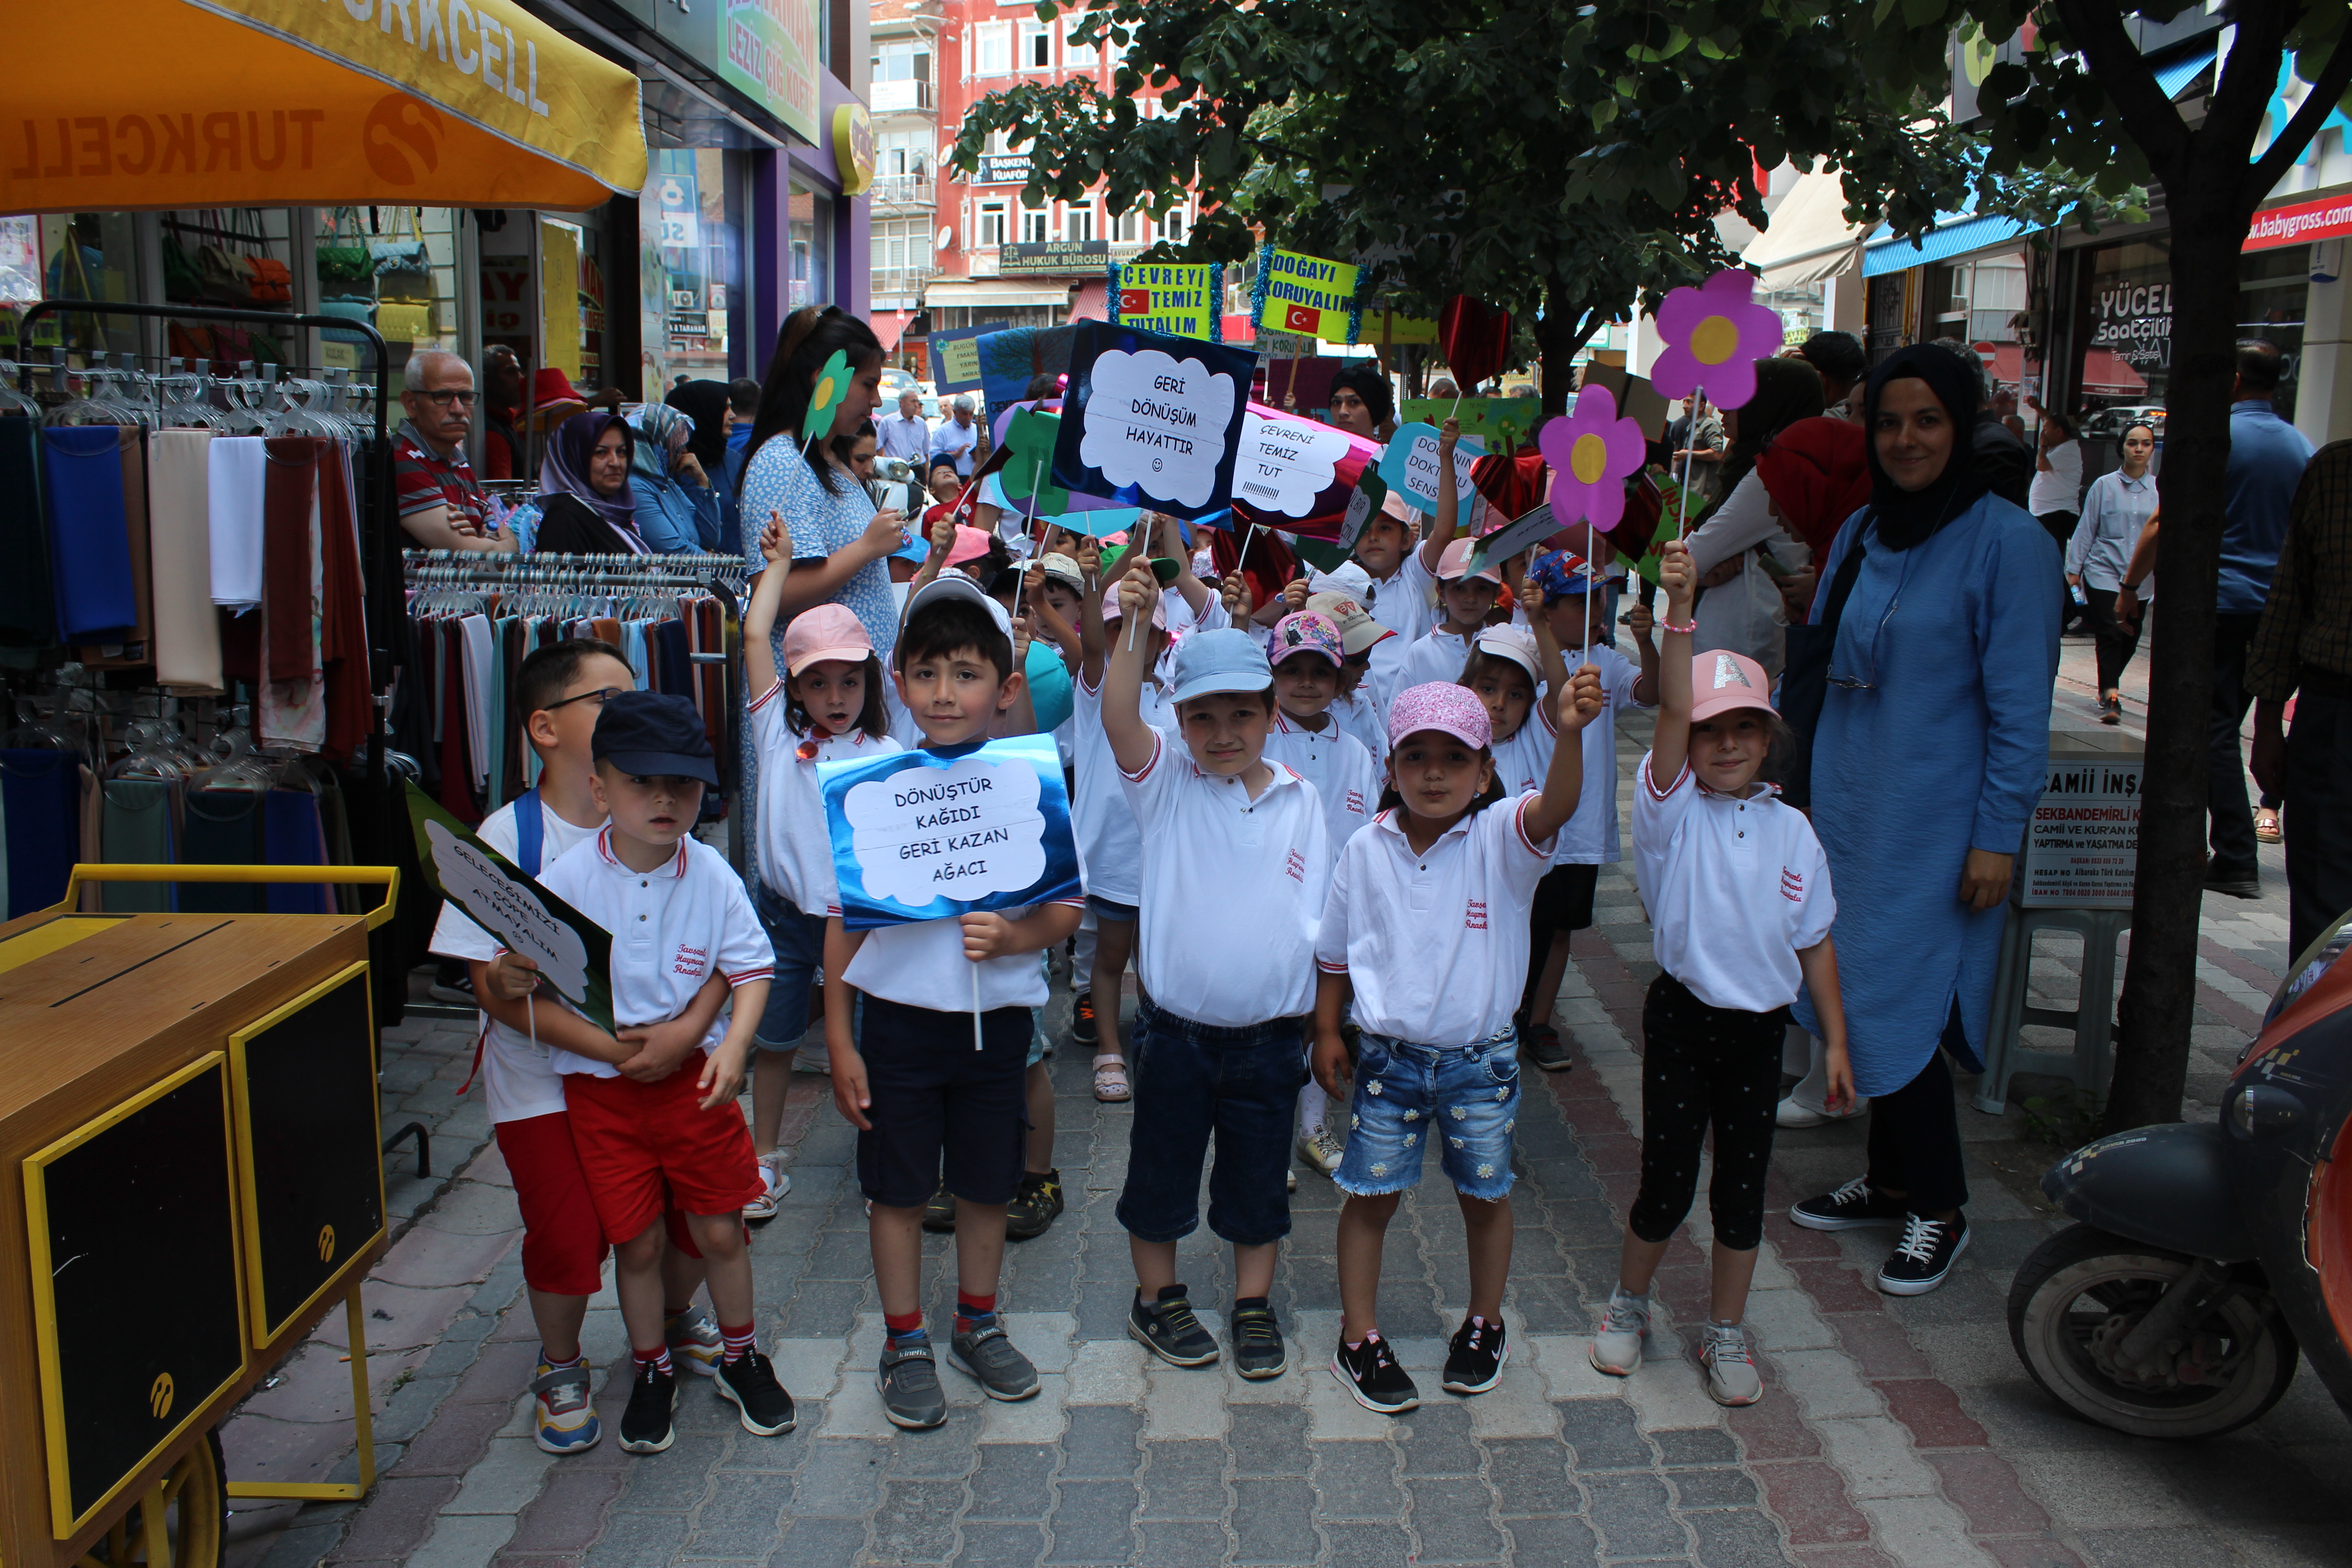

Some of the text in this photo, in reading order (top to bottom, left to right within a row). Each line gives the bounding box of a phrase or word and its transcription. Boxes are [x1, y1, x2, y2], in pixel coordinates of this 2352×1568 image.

[318, 0, 549, 117] RKCELL
[727, 15, 762, 83] LEZİZ
[764, 40, 815, 123] ÇİĞ KÖFTE
[992, 169, 1029, 181] KUAFÖR
[1045, 242, 1083, 253] ARGUN
[1022, 255, 1058, 266] HUKUK
[1062, 252, 1106, 265] BÜROSU
[1273, 254, 1336, 283] DOĞAYI
[1124, 266, 1204, 288] ÇEVREYİ
[1152, 288, 1202, 309] TEMİZ
[2101, 281, 2172, 318] YÜCEL
[1127, 316, 1196, 334] TUTALIM
[1154, 374, 1186, 395] GERİ
[1132, 398, 1196, 427] DÖNÜŞÜM
[1126, 426, 1193, 456] HAYATTIR
[1259, 425, 1315, 445] ÇEVRENİ
[1259, 442, 1299, 461] TEMİZ
[1258, 463, 1283, 478] TUT
[1714, 654, 1752, 690] A
[894, 777, 993, 807] DÖNÜŞTÜR
[916, 805, 982, 830] KAĞIDI
[2035, 806, 2131, 822] SEKBANDEMİRLİ
[2034, 823, 2065, 834] CAMİİ
[2068, 826, 2082, 834] VE
[899, 827, 1009, 860] GERİ KAZAN
[2034, 838, 2074, 848] YAPTIRMA
[2087, 839, 2124, 851] YAŞATMA
[932, 860, 988, 882] AĞACI
[2075, 868, 2099, 877] Albaraka
[2102, 868, 2113, 877] Türk
[454, 845, 561, 936] GELECEĞİMİZİ
[976, 1327, 1000, 1340] kinetix
[899, 1349, 927, 1359] kinetix
